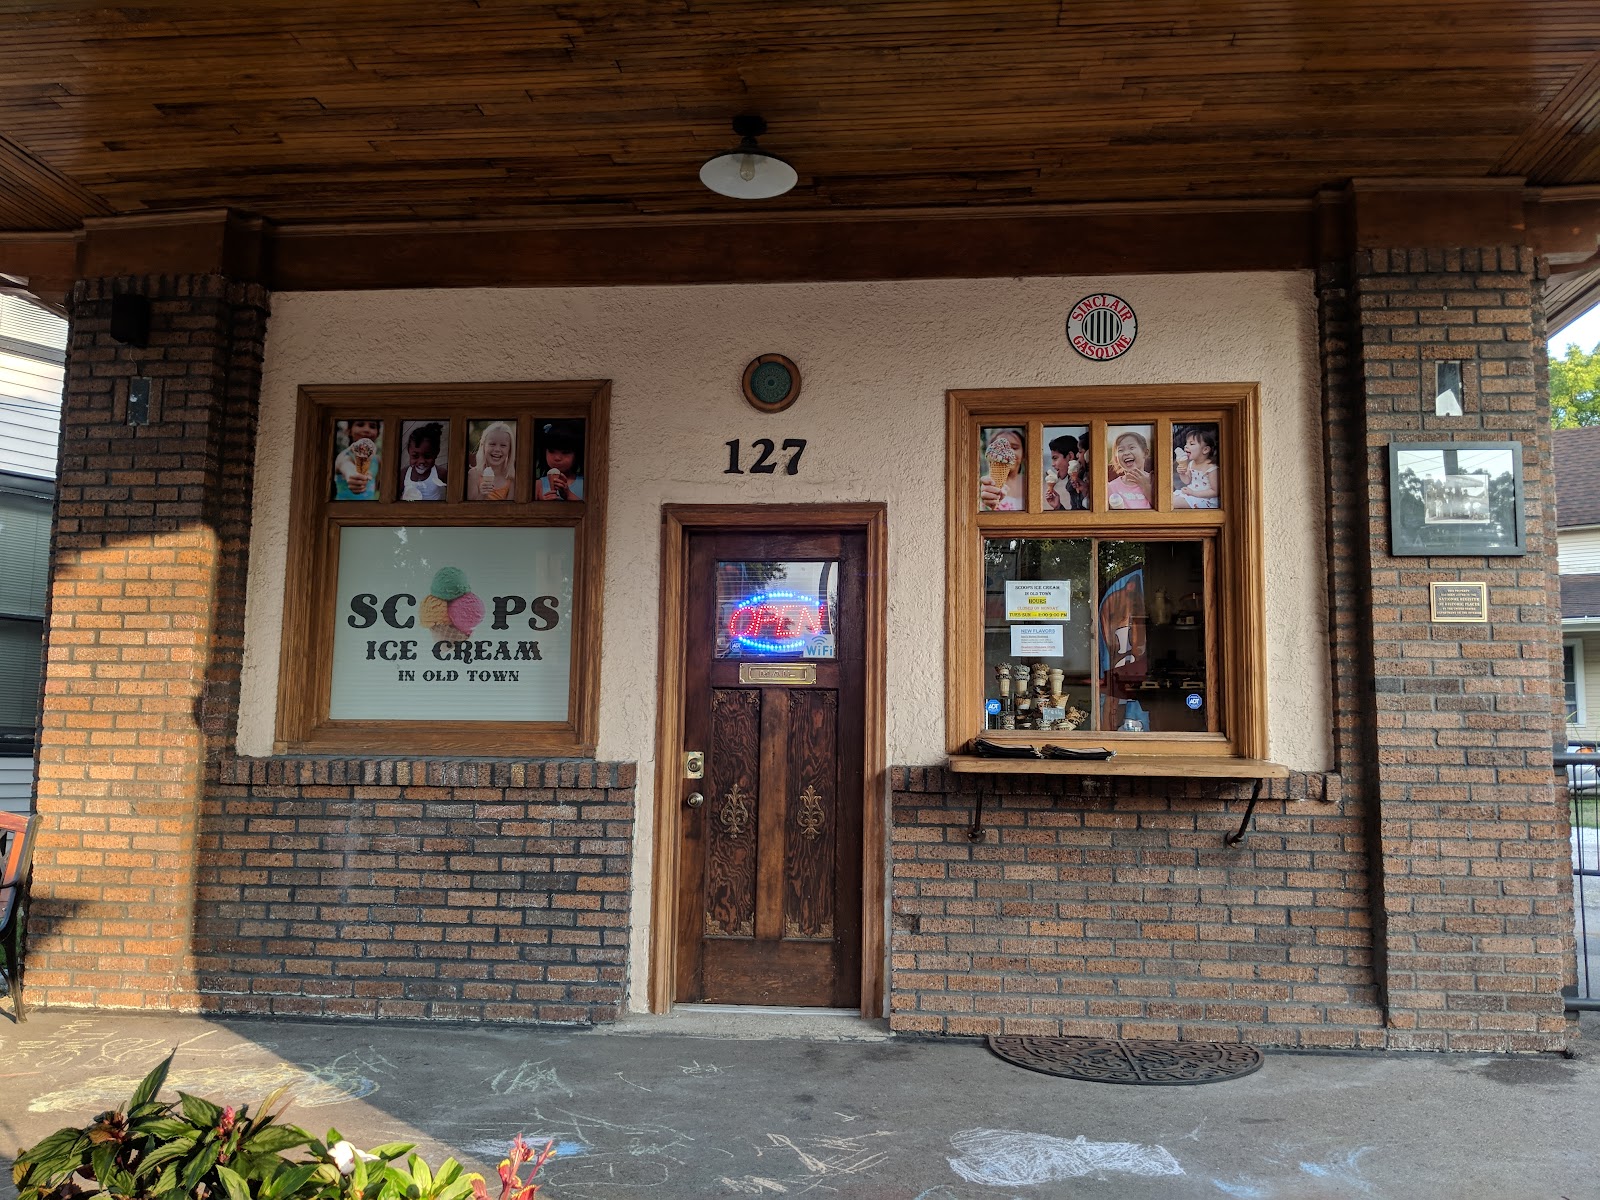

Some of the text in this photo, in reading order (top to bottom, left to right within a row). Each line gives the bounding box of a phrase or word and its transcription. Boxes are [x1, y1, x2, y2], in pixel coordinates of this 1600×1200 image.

[1072, 296, 1133, 322] SINCLAIR
[1073, 335, 1132, 359] GASOLINE
[723, 438, 807, 475] 127
[728, 604, 825, 638] OPEN
[366, 641, 543, 664] ICE CREAM
[806, 645, 833, 656] WiFi
[398, 670, 519, 682] IN OLD TOWN
